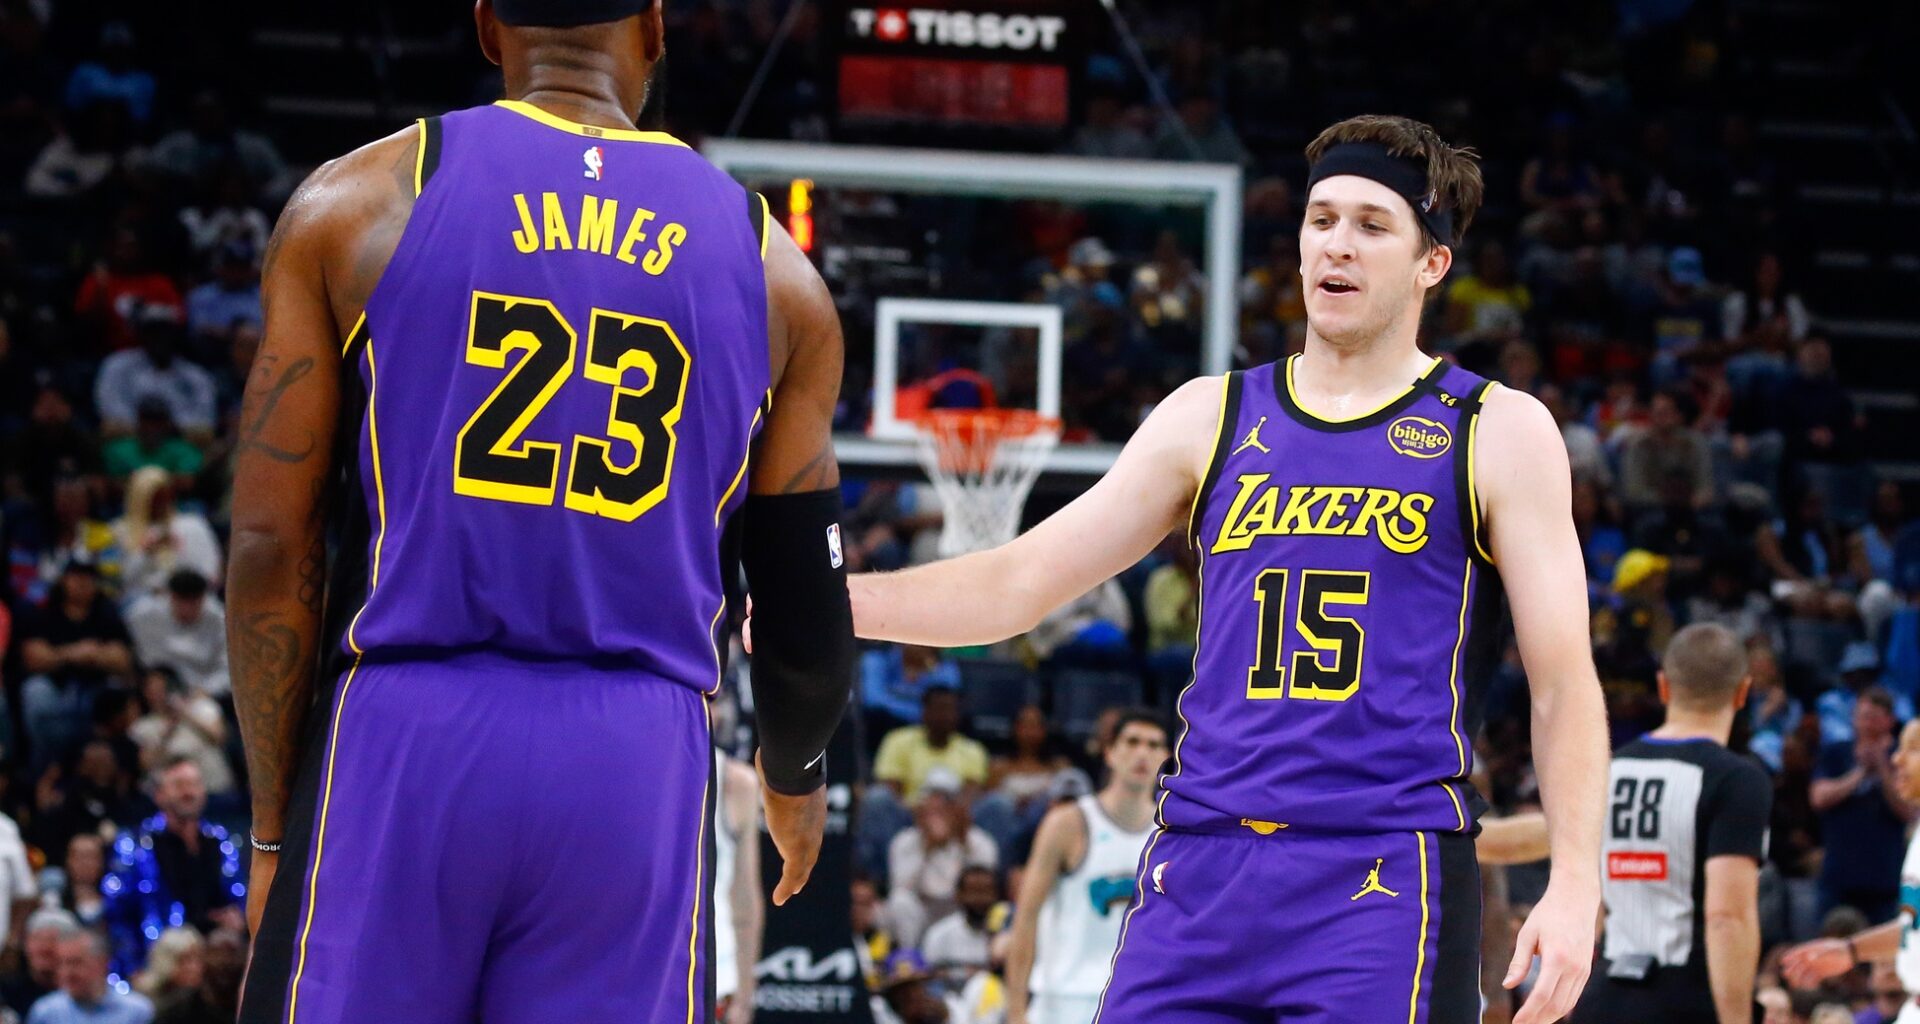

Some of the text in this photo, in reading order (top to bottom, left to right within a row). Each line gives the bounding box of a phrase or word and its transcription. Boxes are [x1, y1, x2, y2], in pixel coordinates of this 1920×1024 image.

[908, 8, 1066, 51] TISSOT
[511, 191, 688, 276] JAMES
[453, 289, 692, 523] 23
[1440, 393, 1458, 407] 44
[1394, 424, 1448, 449] bibigo
[1210, 473, 1435, 555] LAKERS
[1246, 568, 1371, 702] 15
[1612, 777, 1664, 839] 28
